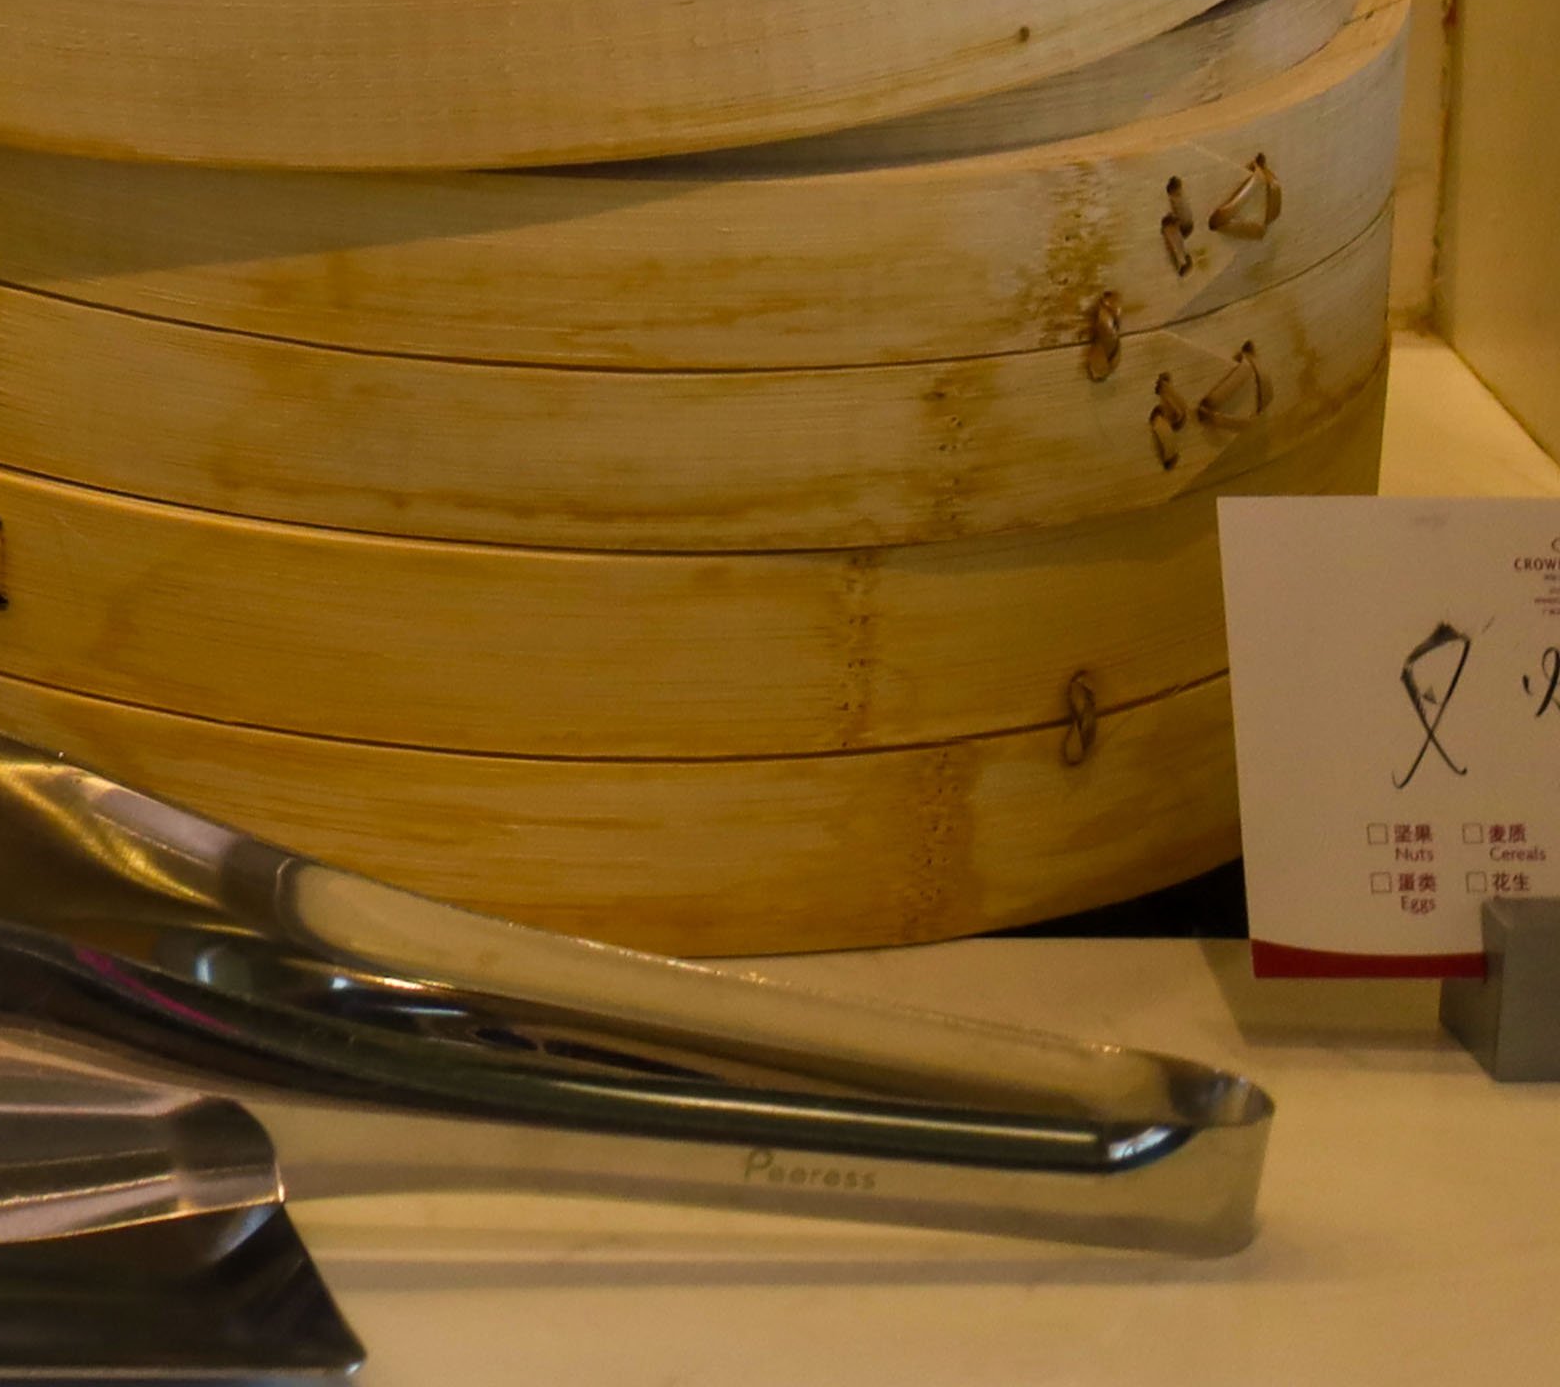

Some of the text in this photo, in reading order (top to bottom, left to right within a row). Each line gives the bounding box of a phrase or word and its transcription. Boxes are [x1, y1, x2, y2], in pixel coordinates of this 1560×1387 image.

[1514, 556, 1560, 572] CROW
[1396, 847, 1434, 861] Nuts
[1489, 847, 1546, 861] Cereals
[1492, 872, 1530, 891] 花生
[1401, 896, 1436, 914] Eggs
